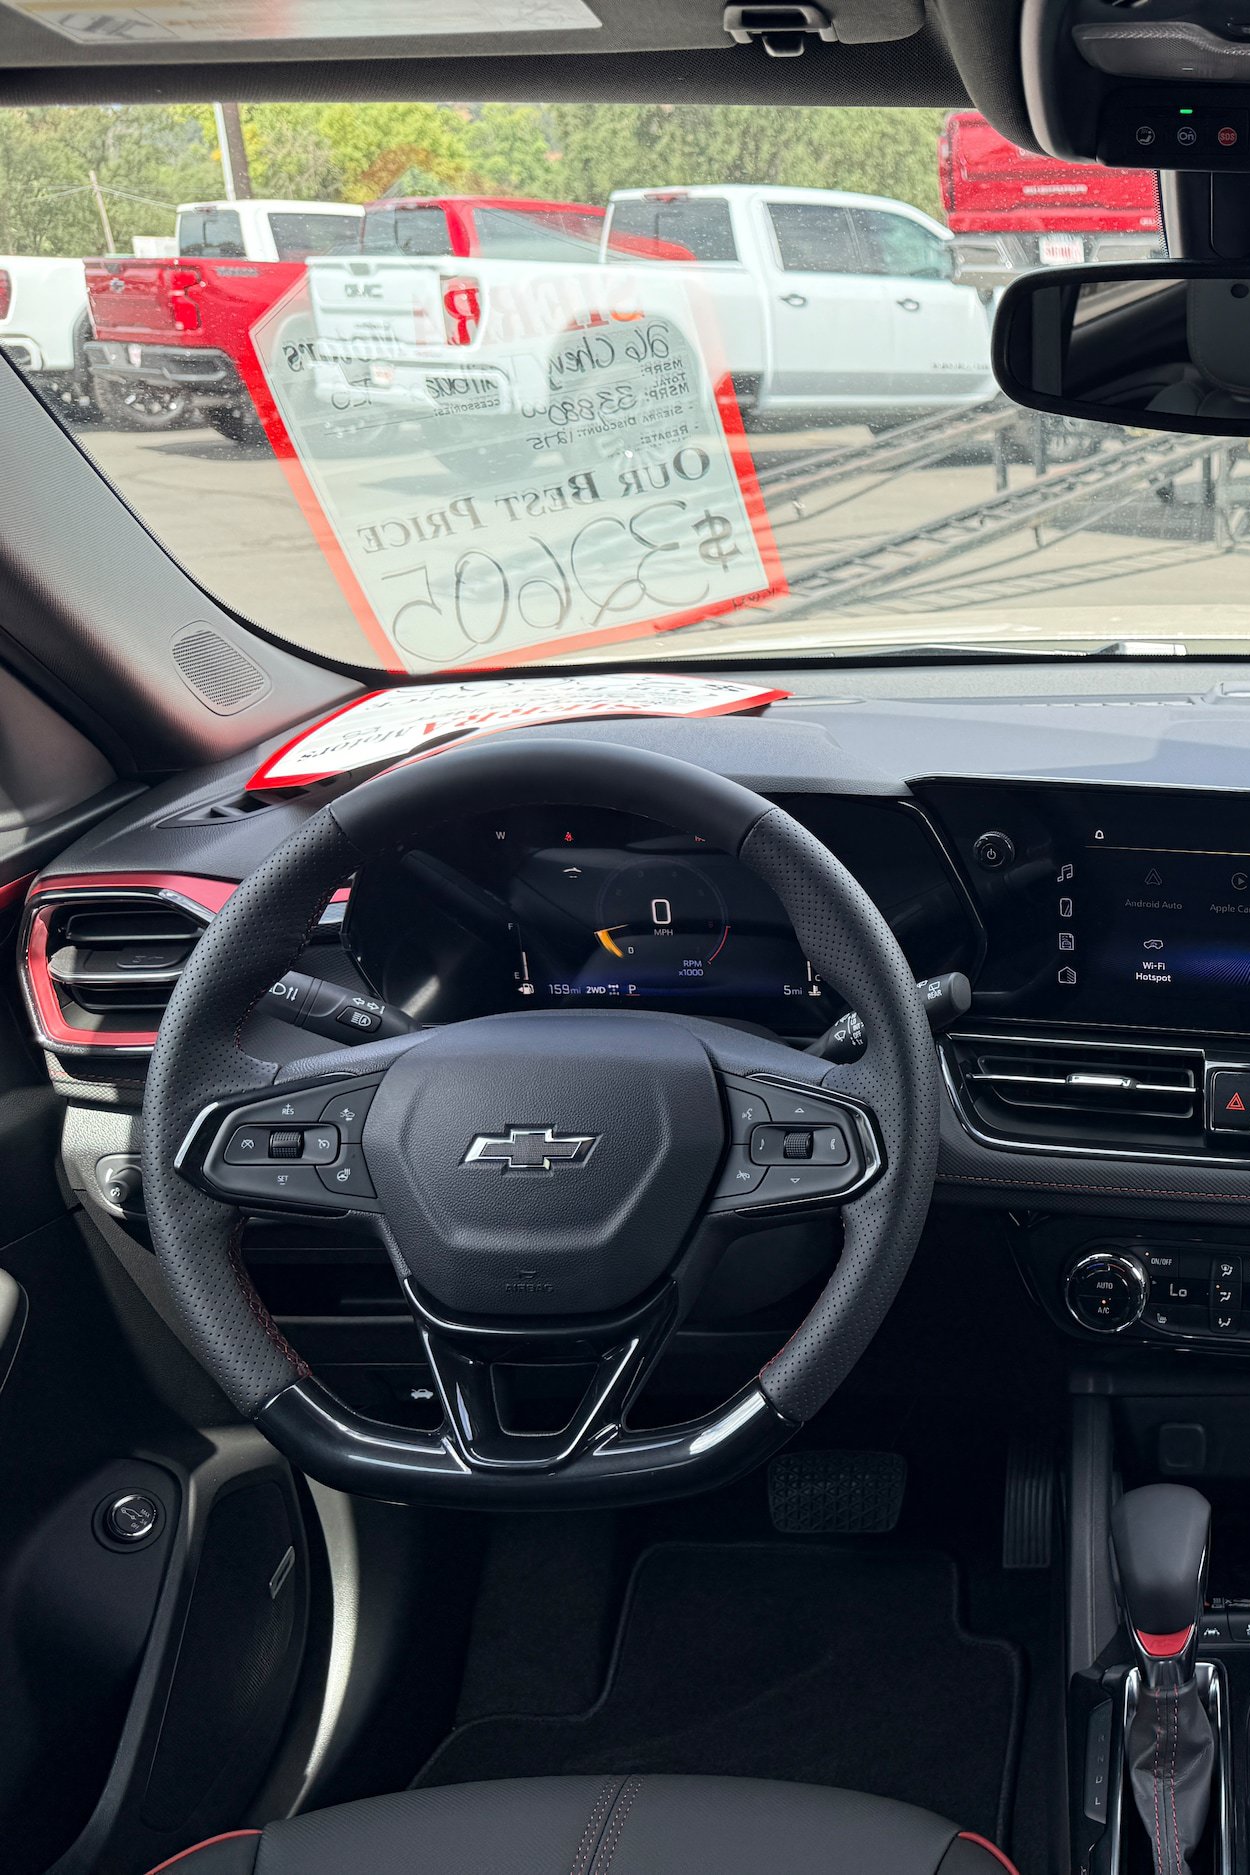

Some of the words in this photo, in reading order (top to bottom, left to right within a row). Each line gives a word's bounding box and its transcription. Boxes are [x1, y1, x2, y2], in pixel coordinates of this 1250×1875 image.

[495, 831, 506, 840] W
[1125, 898, 1158, 910] Android
[1159, 900, 1183, 910] Auto
[651, 898, 672, 925] 0
[1210, 904, 1235, 916] Apple
[653, 928, 674, 937] MPH
[683, 960, 703, 968] RPM
[1142, 961, 1166, 971] Wi-Fi
[678, 969, 704, 977] x1000
[1135, 972, 1171, 984] Hotspot
[586, 985, 606, 995] 2WD
[627, 983, 637, 994] P
[1150, 1257, 1172, 1266] ON/OFF
[1096, 1281, 1113, 1290] AUTO
[1169, 1283, 1188, 1298] Lo
[1097, 1305, 1110, 1315] A/C
